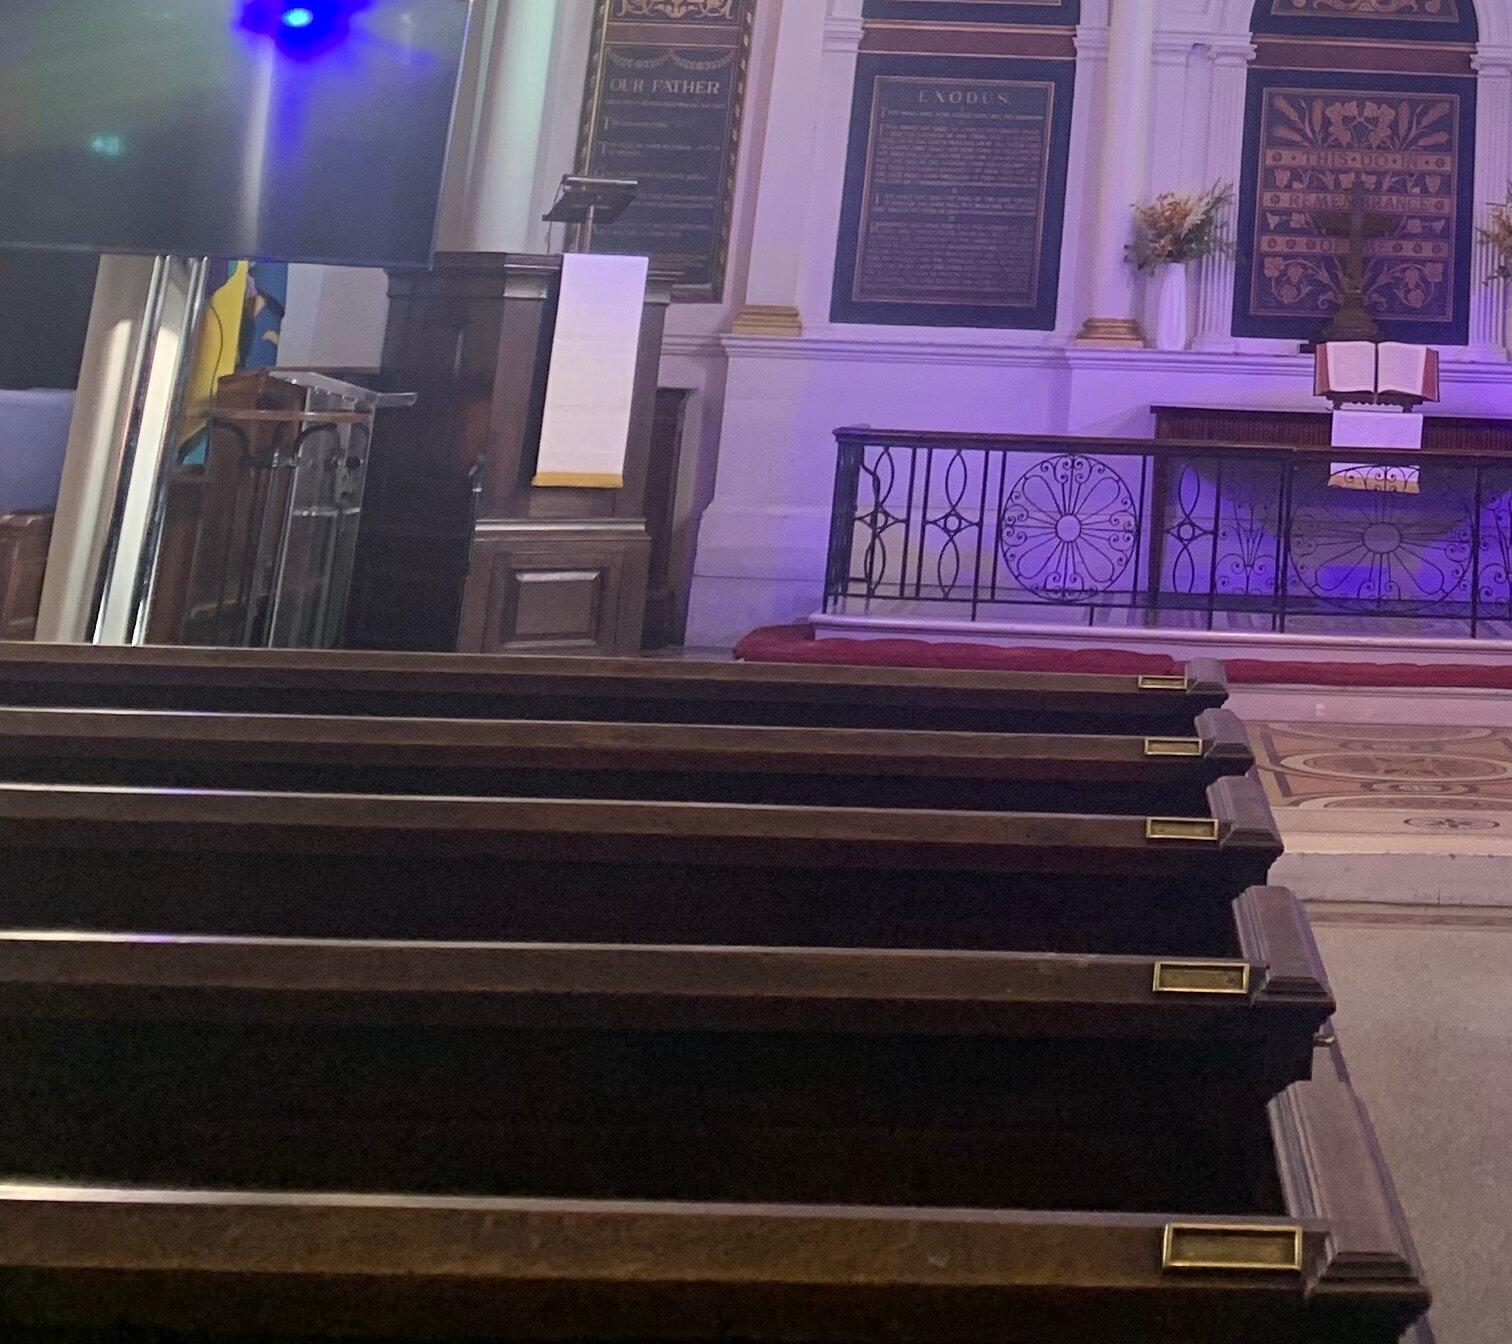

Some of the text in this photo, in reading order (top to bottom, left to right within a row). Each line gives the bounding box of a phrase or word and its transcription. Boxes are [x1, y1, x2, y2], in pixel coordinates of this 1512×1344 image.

[610, 78, 720, 95] OUR FATHER
[1302, 152, 1419, 169] THIS DO IN
